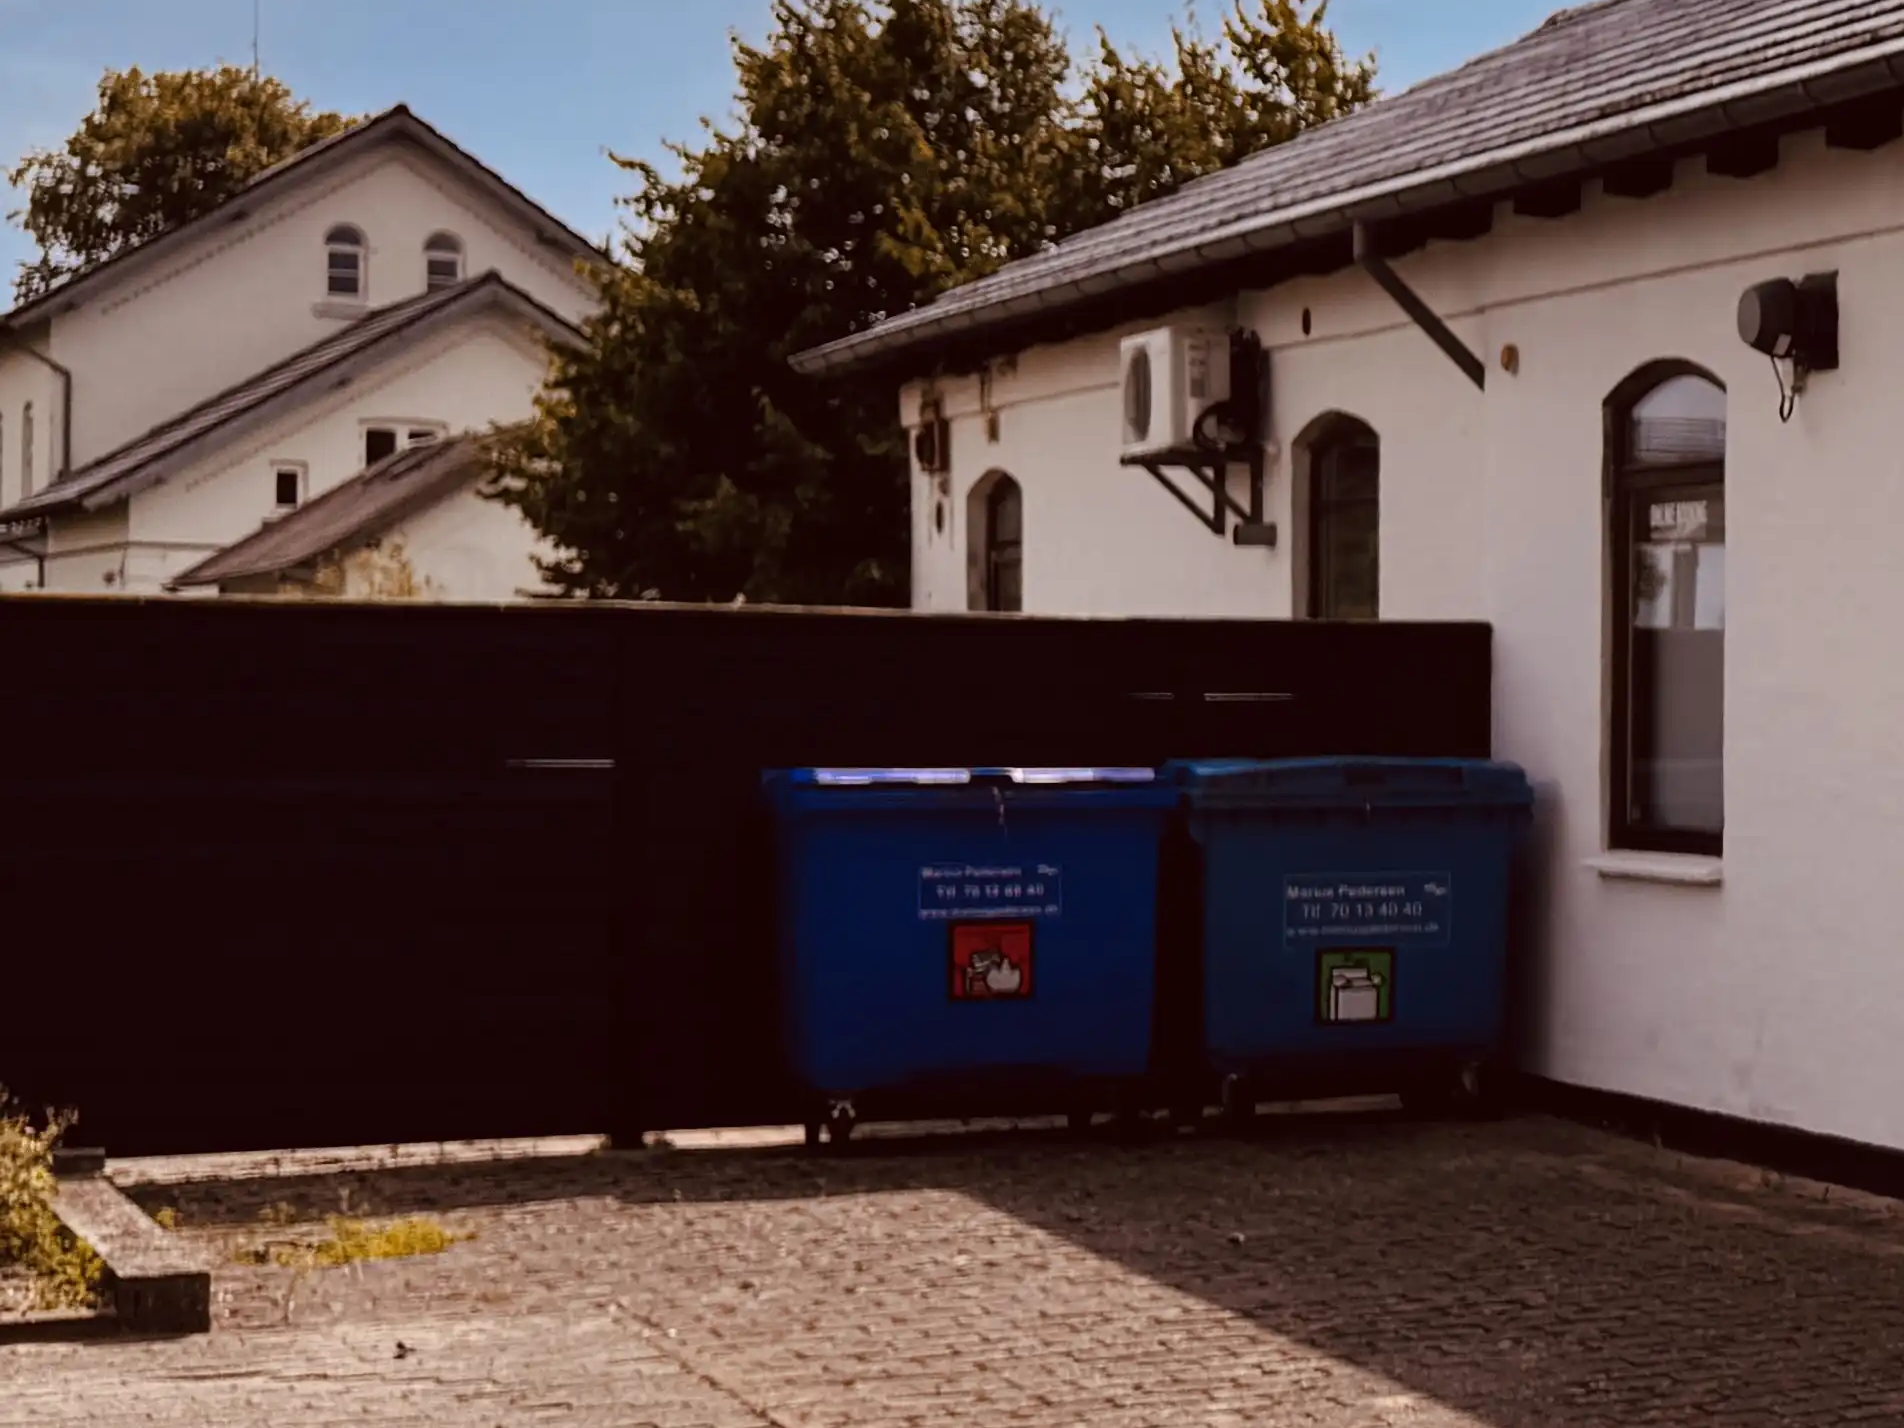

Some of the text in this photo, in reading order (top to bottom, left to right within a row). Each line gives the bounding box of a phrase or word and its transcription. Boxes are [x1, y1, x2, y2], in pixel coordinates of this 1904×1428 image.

[1286, 883, 1406, 899] Marius Pedersen
[1331, 903, 1350, 919] 70
[1379, 901, 1399, 917] 40
[1402, 901, 1423, 917] 40
